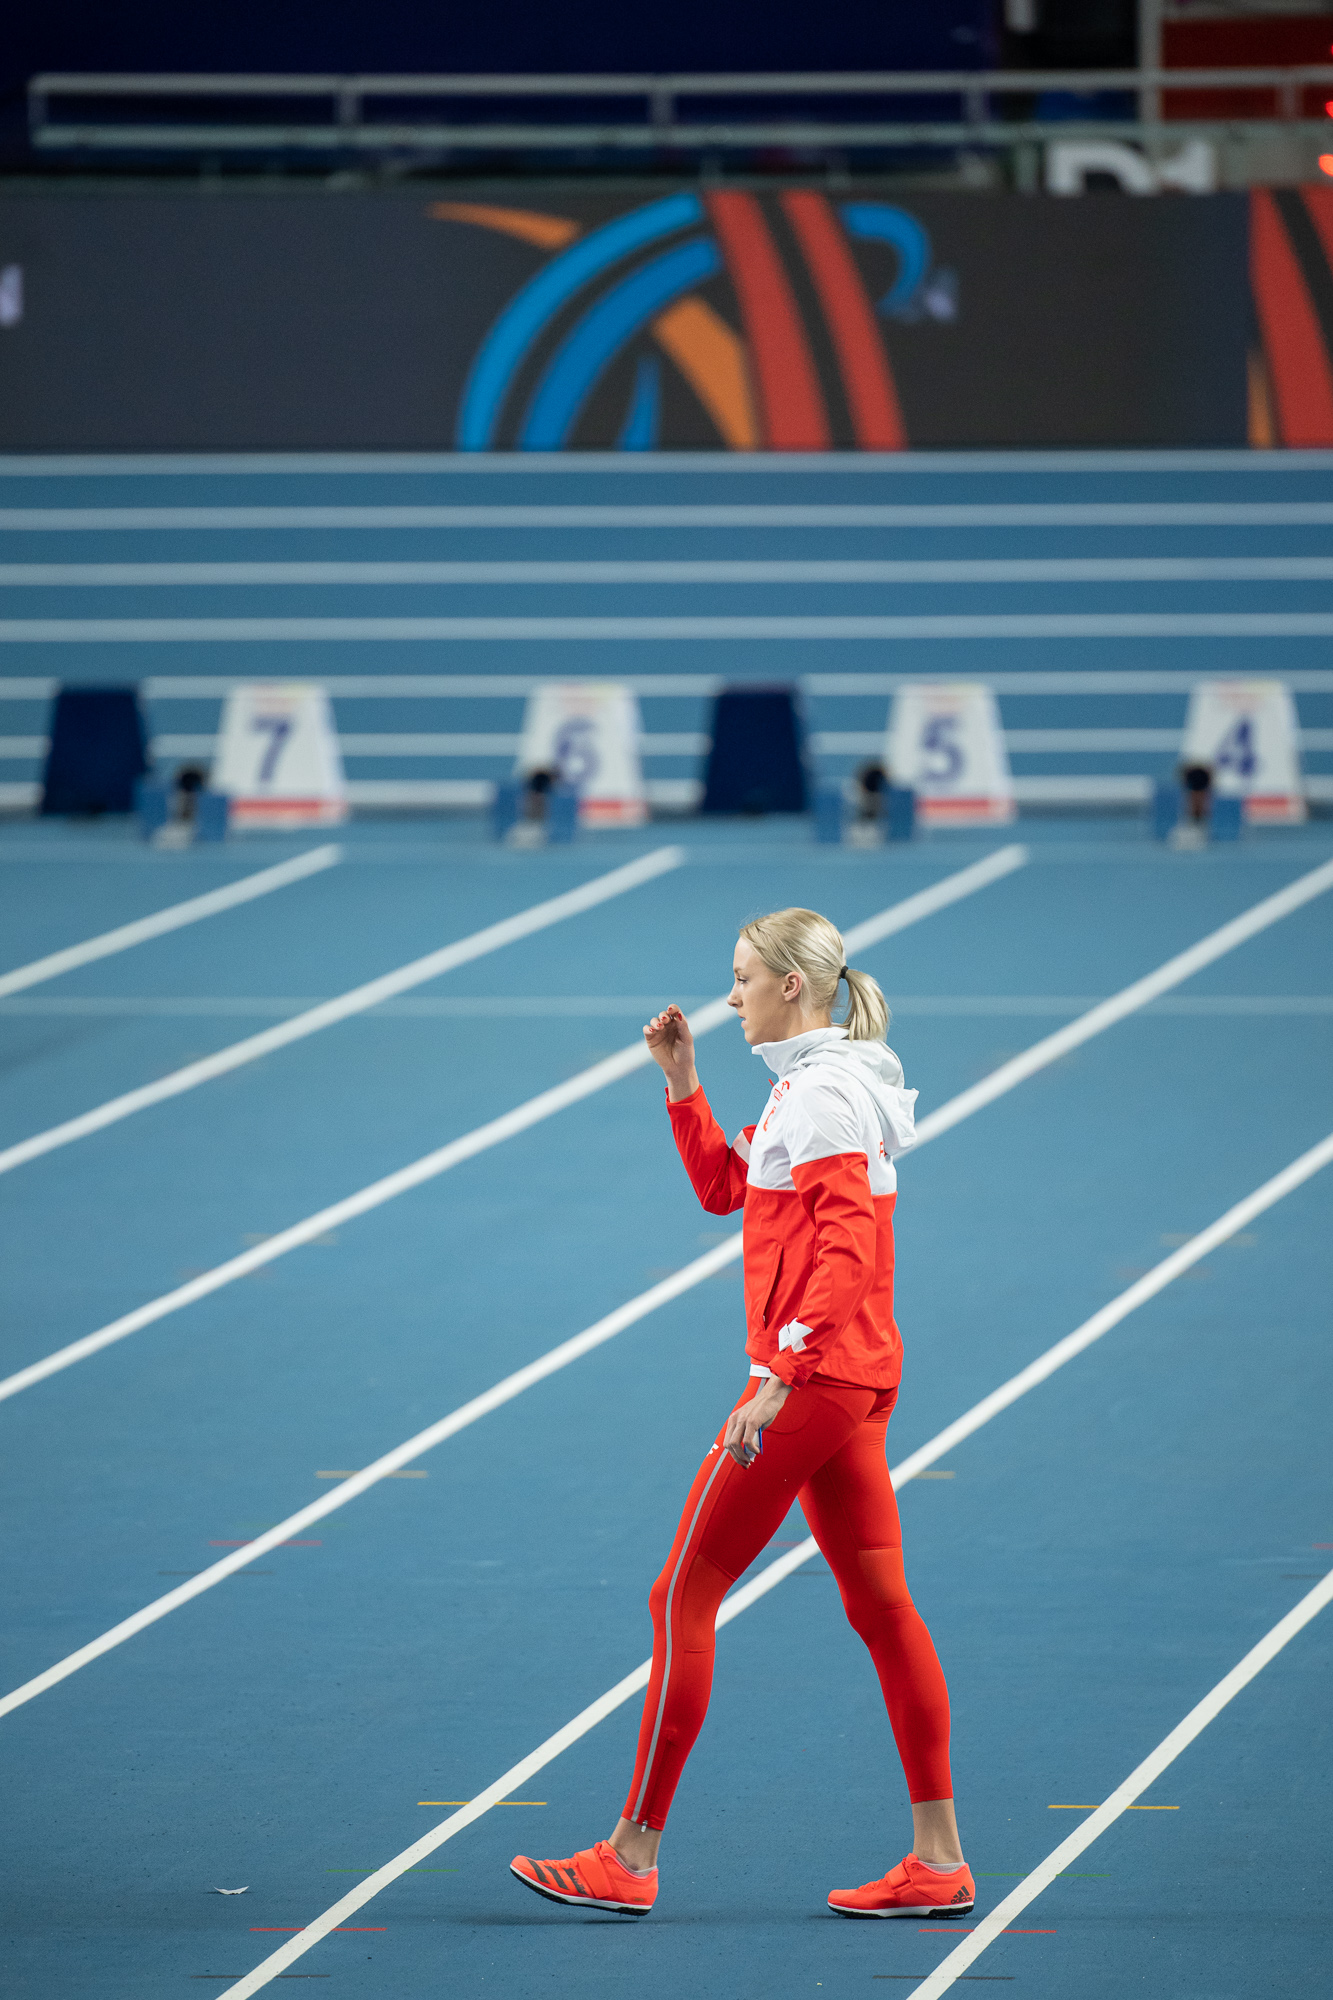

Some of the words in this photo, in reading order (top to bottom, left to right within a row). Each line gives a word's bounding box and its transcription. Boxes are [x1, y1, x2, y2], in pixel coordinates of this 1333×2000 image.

[250, 715, 293, 785] 7
[554, 717, 600, 786] 6
[921, 714, 966, 785] 5
[1214, 716, 1259, 780] 4
